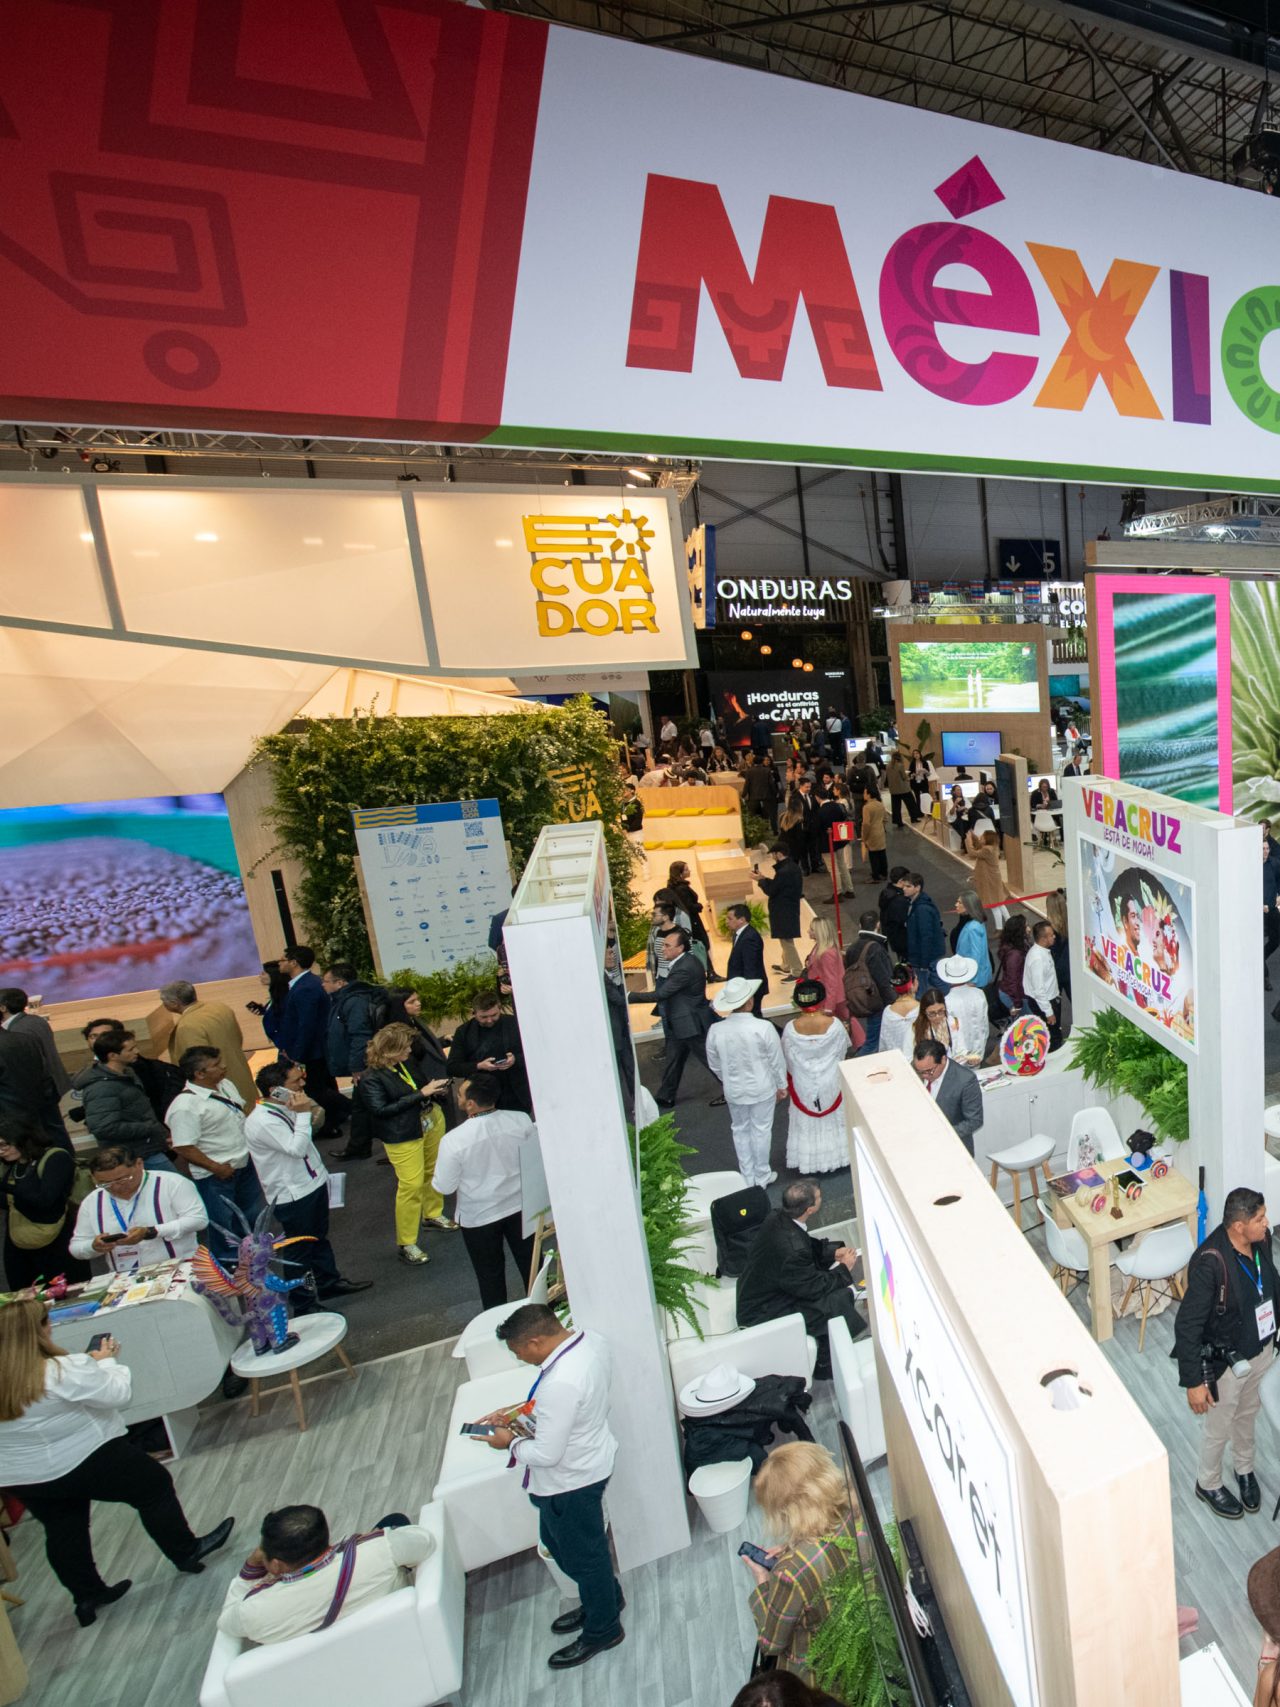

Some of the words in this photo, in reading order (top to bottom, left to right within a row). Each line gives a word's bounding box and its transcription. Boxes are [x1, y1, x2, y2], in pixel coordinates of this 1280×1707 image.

[1042, 552, 1056, 573] 5
[530, 556, 655, 596] CUA
[716, 579, 853, 601] ONDURAS
[729, 602, 801, 619] Naturalmente
[802, 605, 826, 620] tuya
[1059, 600, 1087, 615] CO
[535, 598, 660, 637] DOR
[1074, 620, 1088, 629] PA
[747, 690, 820, 706] ¡Honduras
[758, 711, 770, 720] de
[1081, 786, 1182, 855] VERACRUZ
[1121, 834, 1131, 850] DE
[1101, 934, 1172, 1001] VERACRUZ
